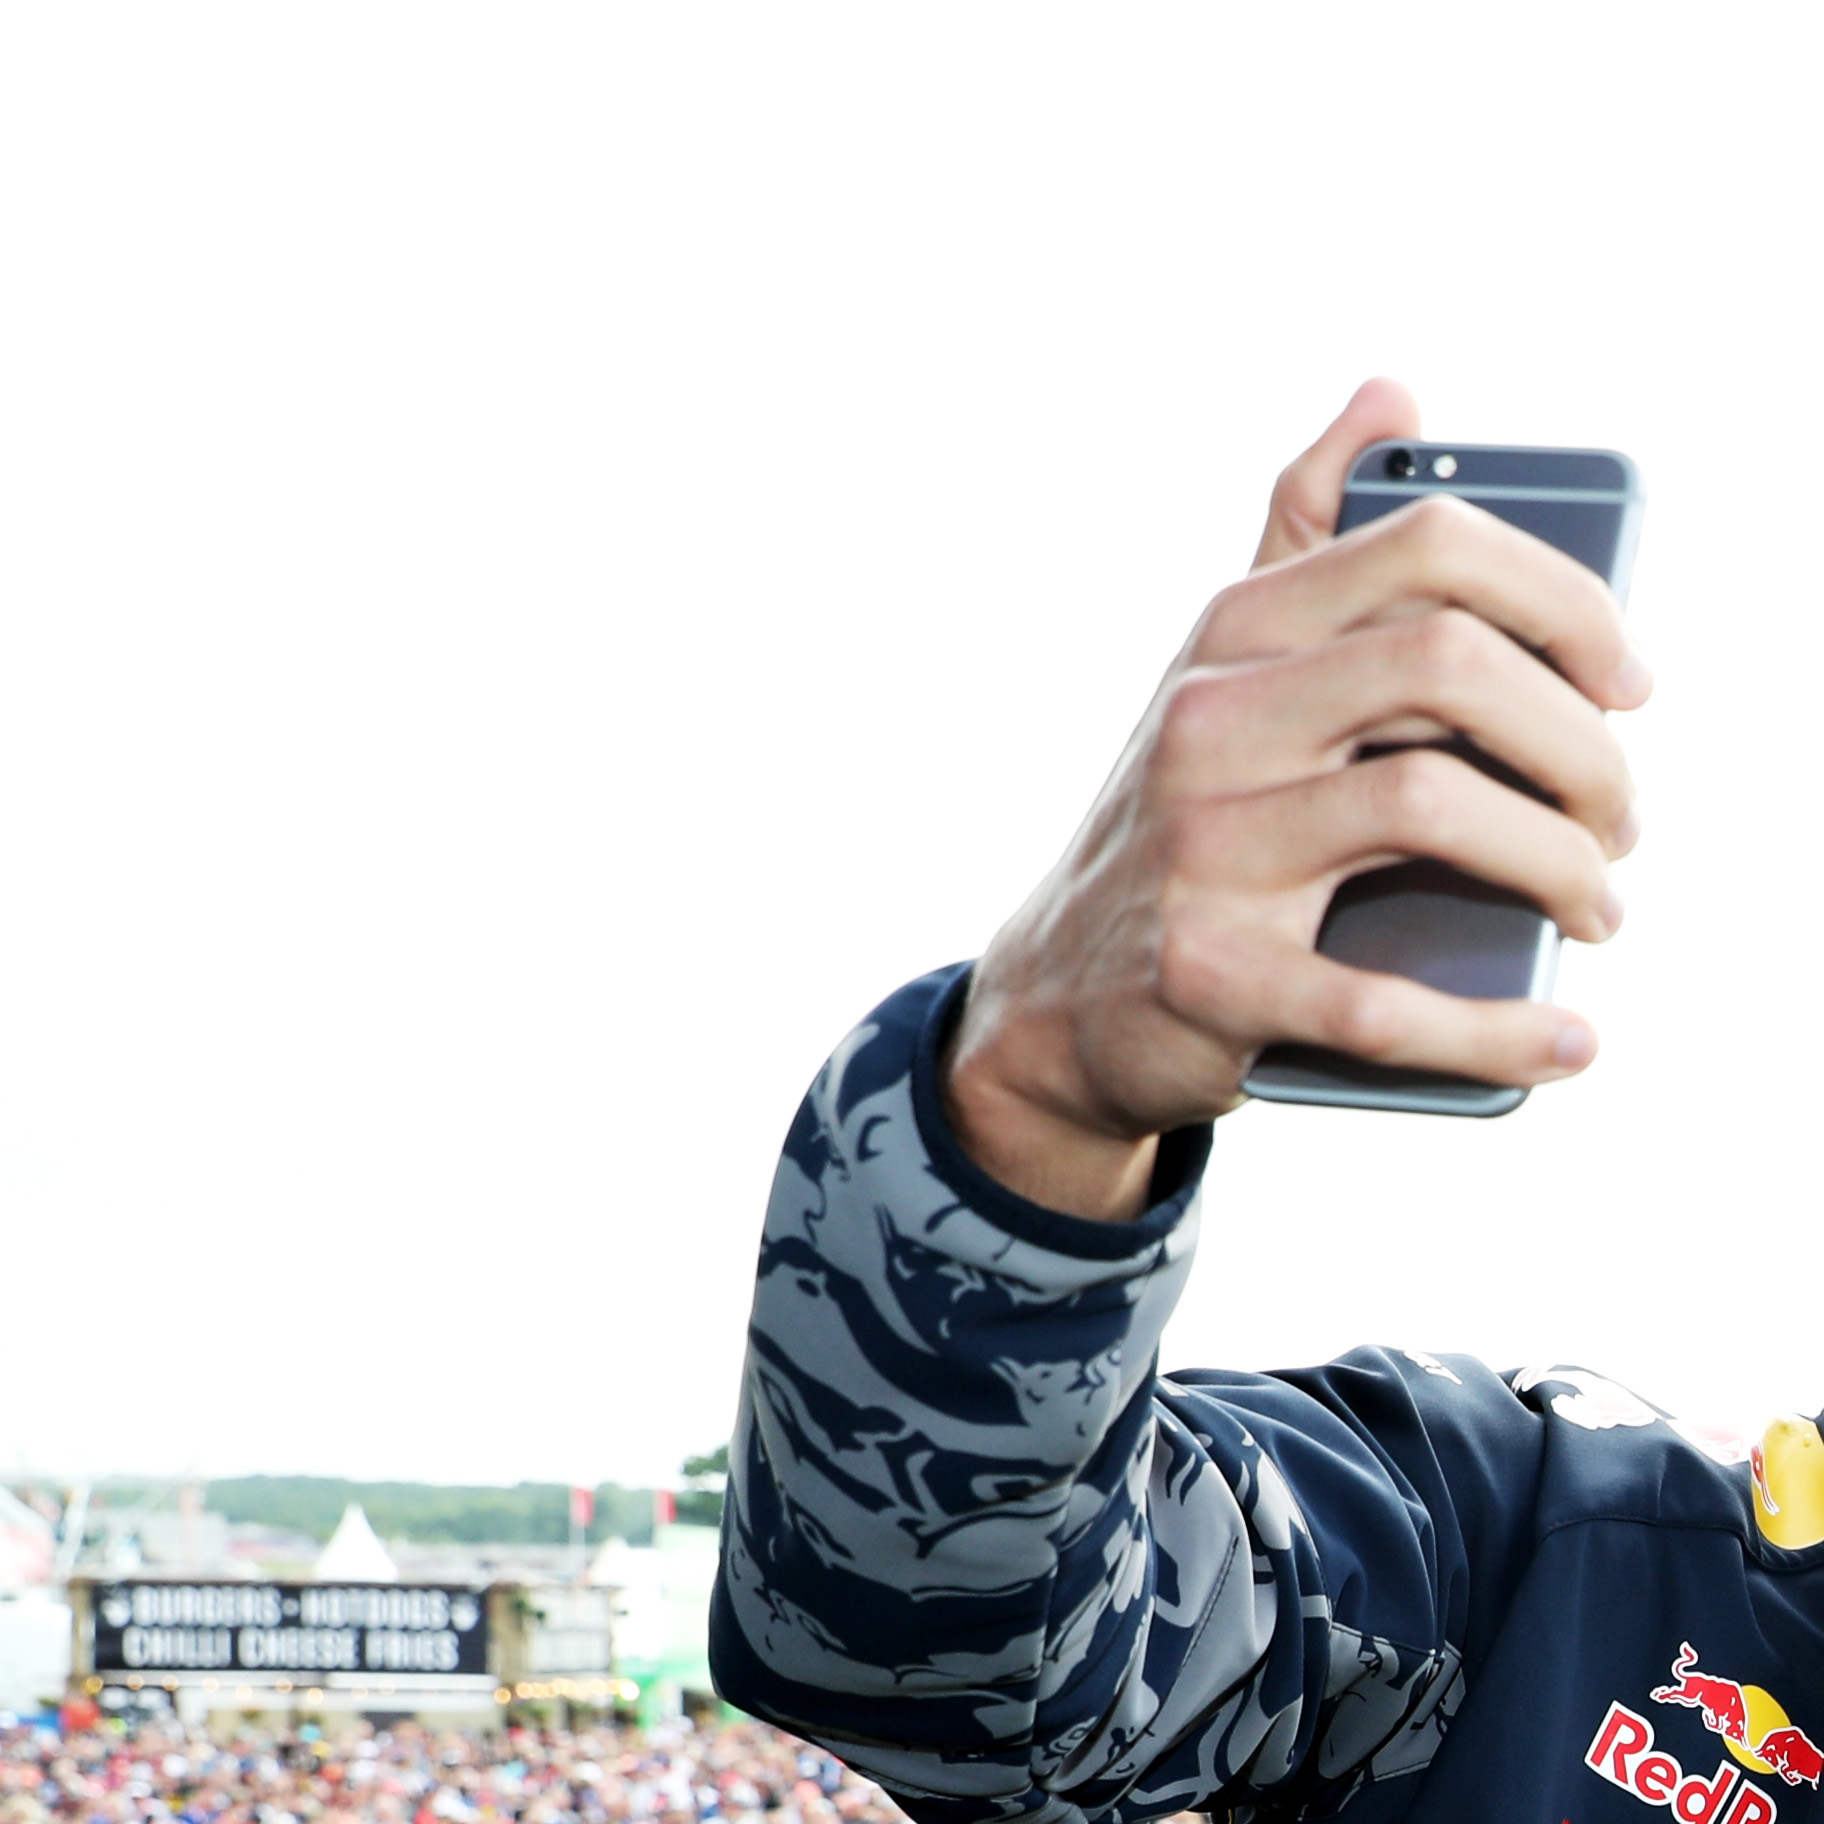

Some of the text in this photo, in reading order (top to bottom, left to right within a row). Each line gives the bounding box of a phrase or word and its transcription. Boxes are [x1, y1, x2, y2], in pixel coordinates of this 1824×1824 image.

[131, 1585, 281, 1628] BURGERS
[122, 1627, 459, 1670] CHILLI CHEESE FRIES
